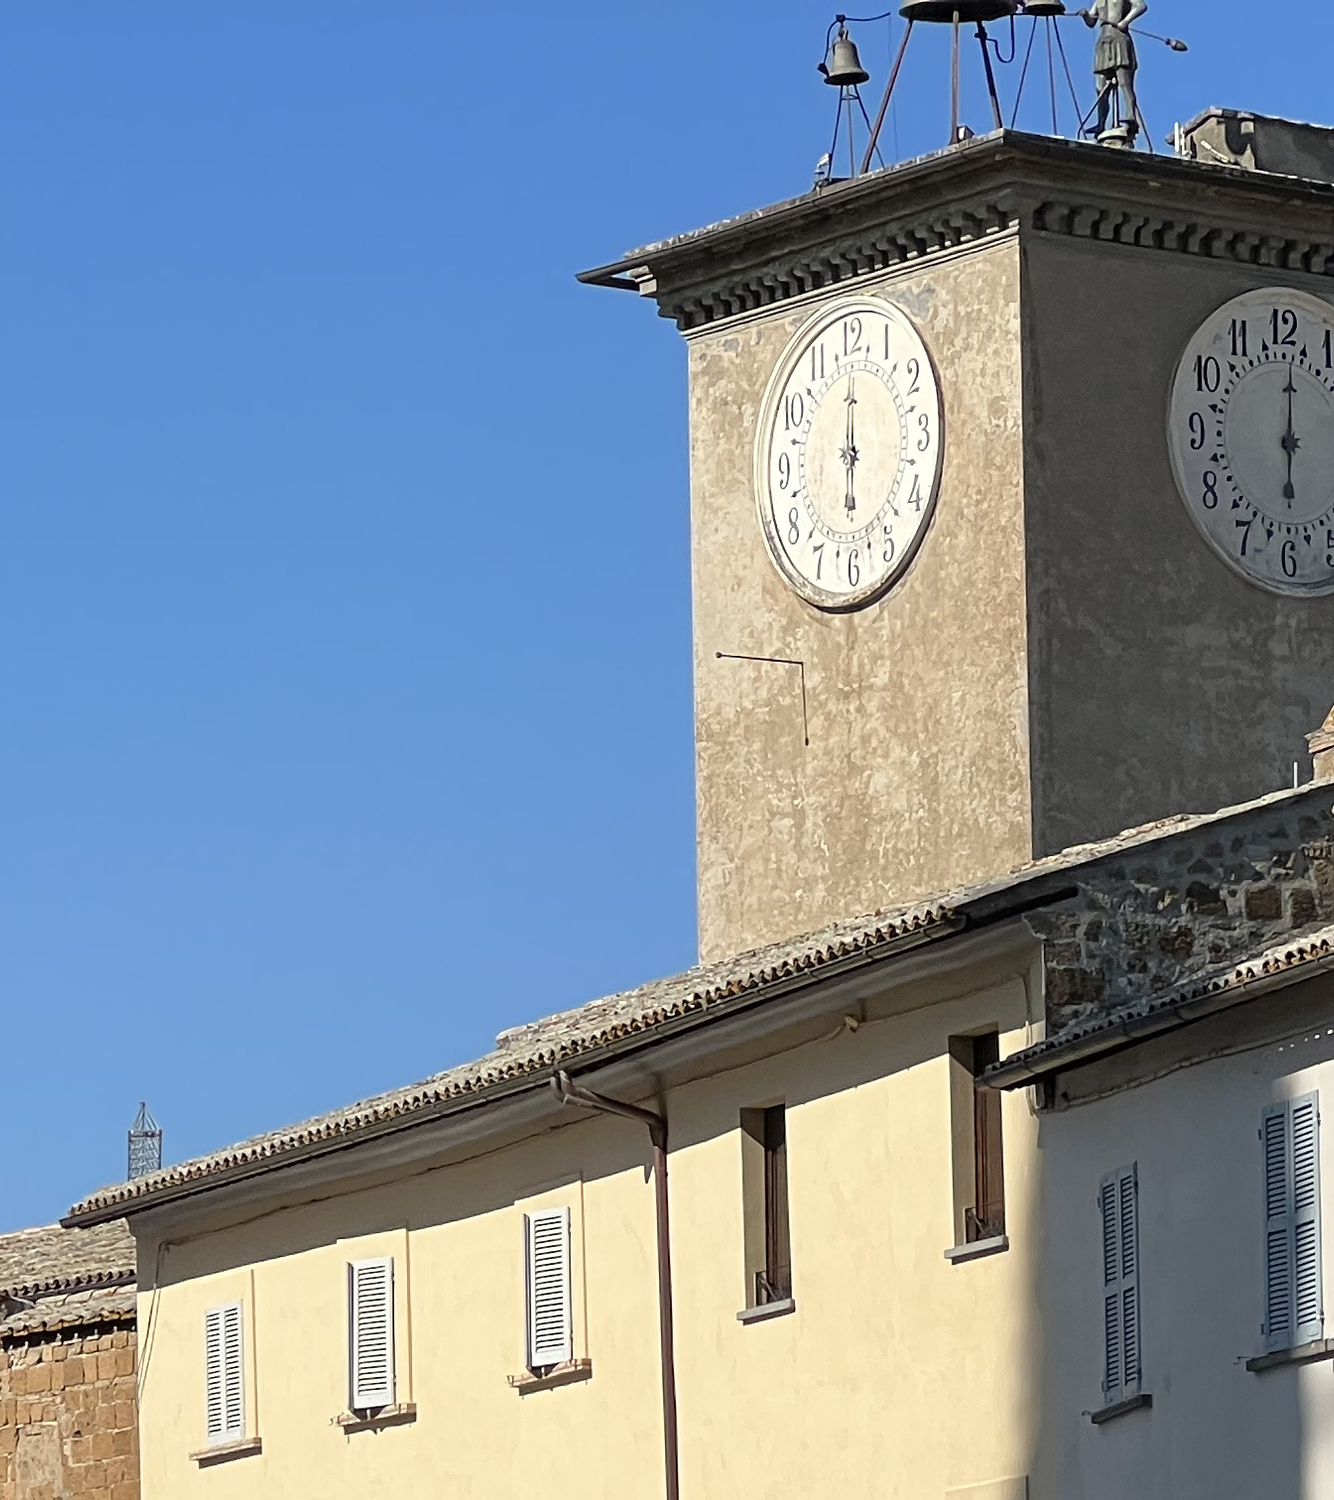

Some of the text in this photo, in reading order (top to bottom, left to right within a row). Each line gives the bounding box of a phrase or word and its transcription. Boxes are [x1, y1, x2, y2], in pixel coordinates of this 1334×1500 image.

[843, 317, 862, 357] 12
[883, 323, 890, 360] 1
[1228, 319, 1248, 357] 11
[1270, 308, 1298, 347] 12
[811, 343, 826, 382] 11
[1322, 329, 1333, 368] 1
[906, 358, 921, 397] 2
[1193, 354, 1220, 393] 10
[784, 392, 804, 431] 10
[1188, 412, 1205, 450] 9
[917, 413, 931, 452] 3
[778, 452, 791, 490] 9
[1202, 470, 1218, 509] 8
[907, 474, 924, 512] 4
[788, 507, 800, 545] 8
[882, 524, 895, 563] 5
[1235, 519, 1253, 556] 7
[812, 542, 826, 581] 7
[848, 549, 860, 587] 6
[1281, 540, 1297, 577] 6
